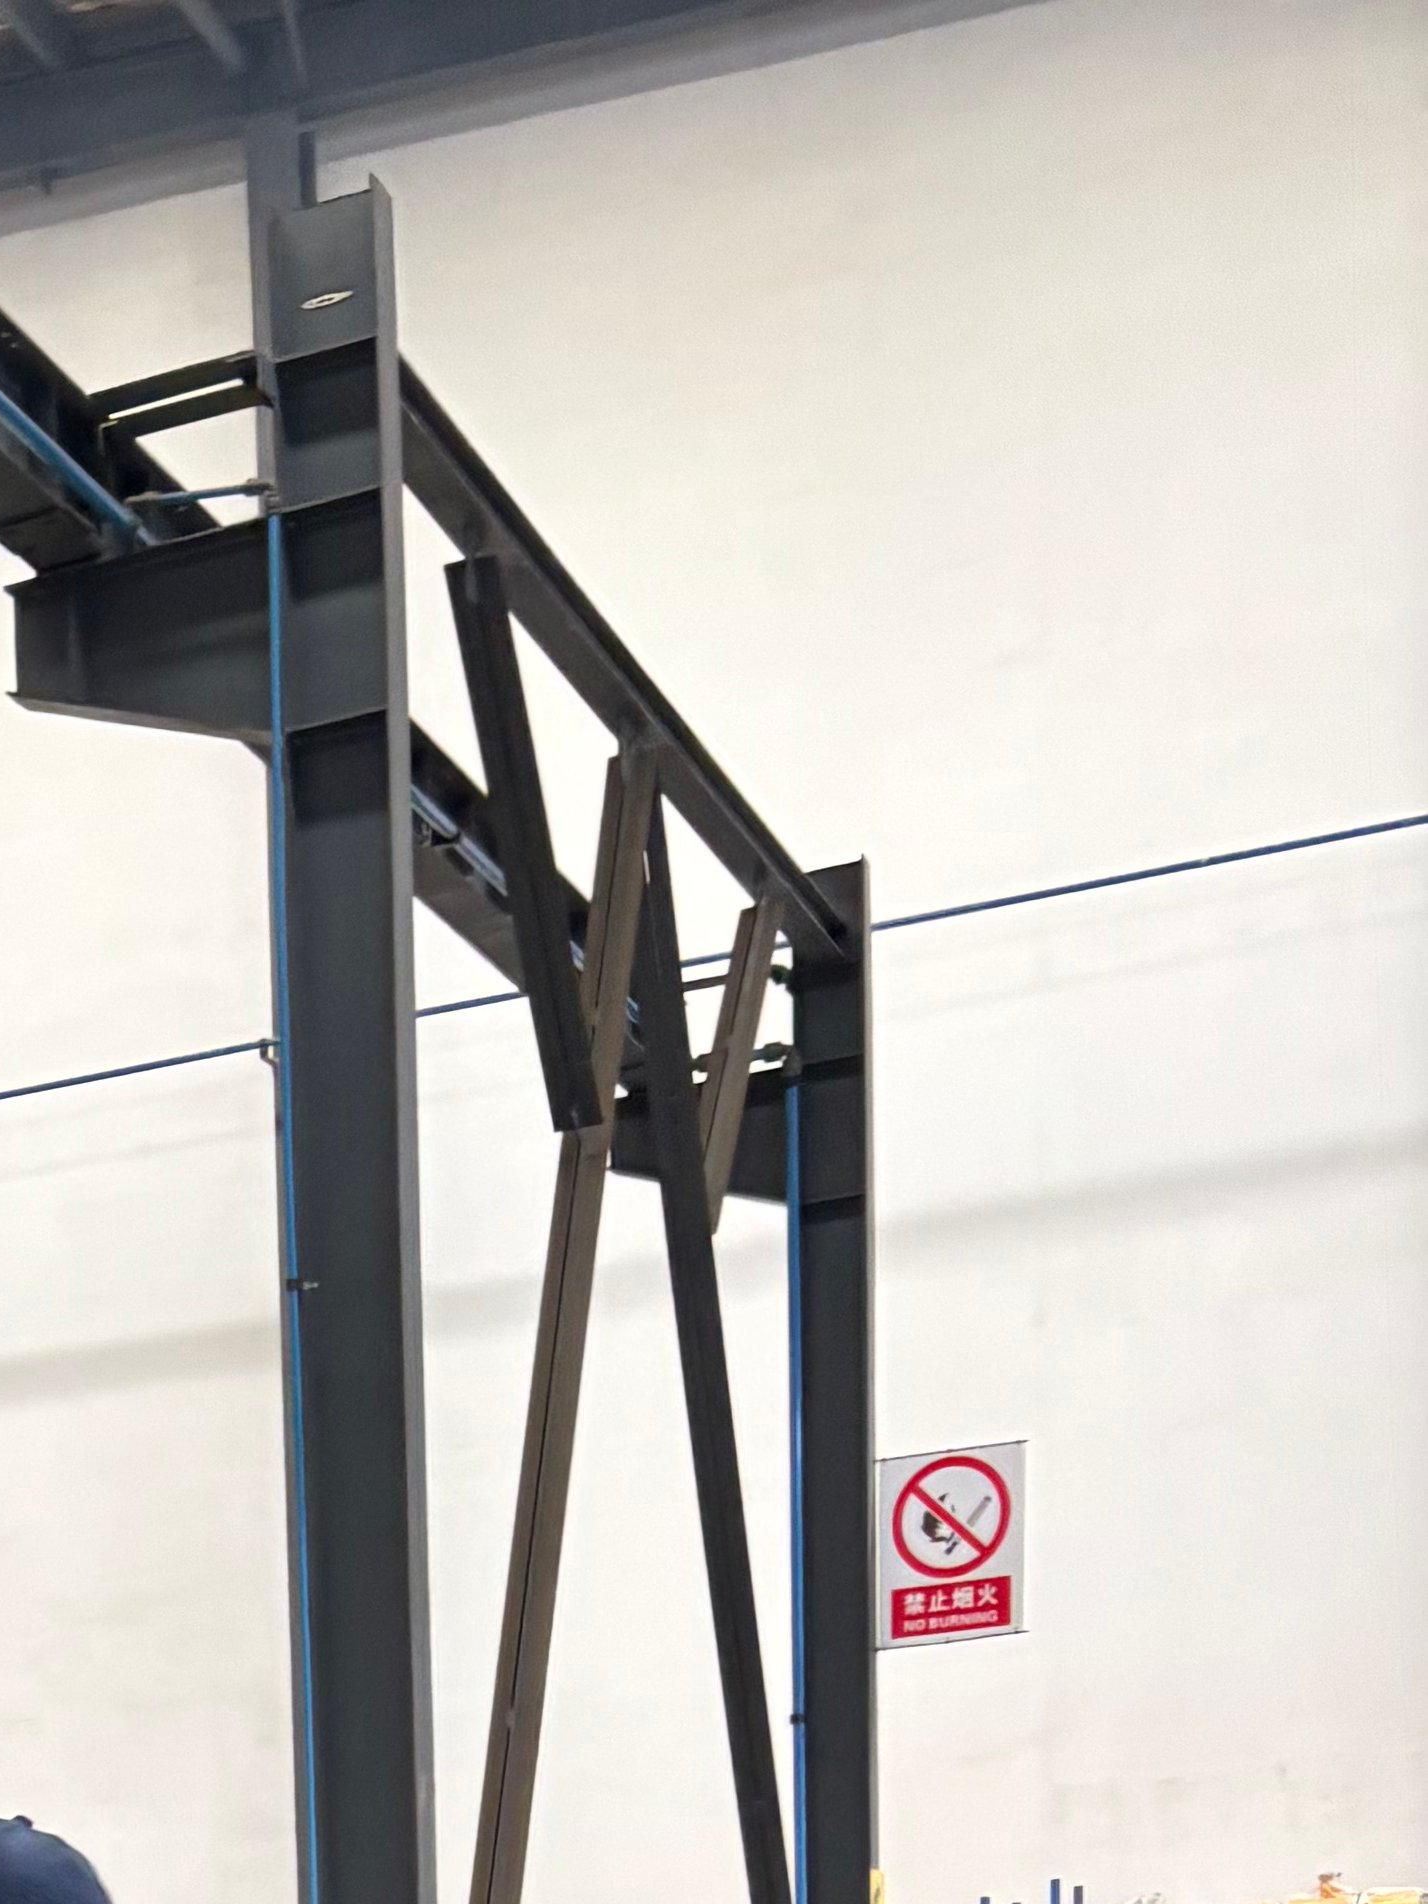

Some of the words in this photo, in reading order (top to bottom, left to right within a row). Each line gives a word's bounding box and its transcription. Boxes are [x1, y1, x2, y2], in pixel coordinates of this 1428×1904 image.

[904, 1583, 998, 1615] 禁止烟火
[904, 1619, 925, 1632] NO
